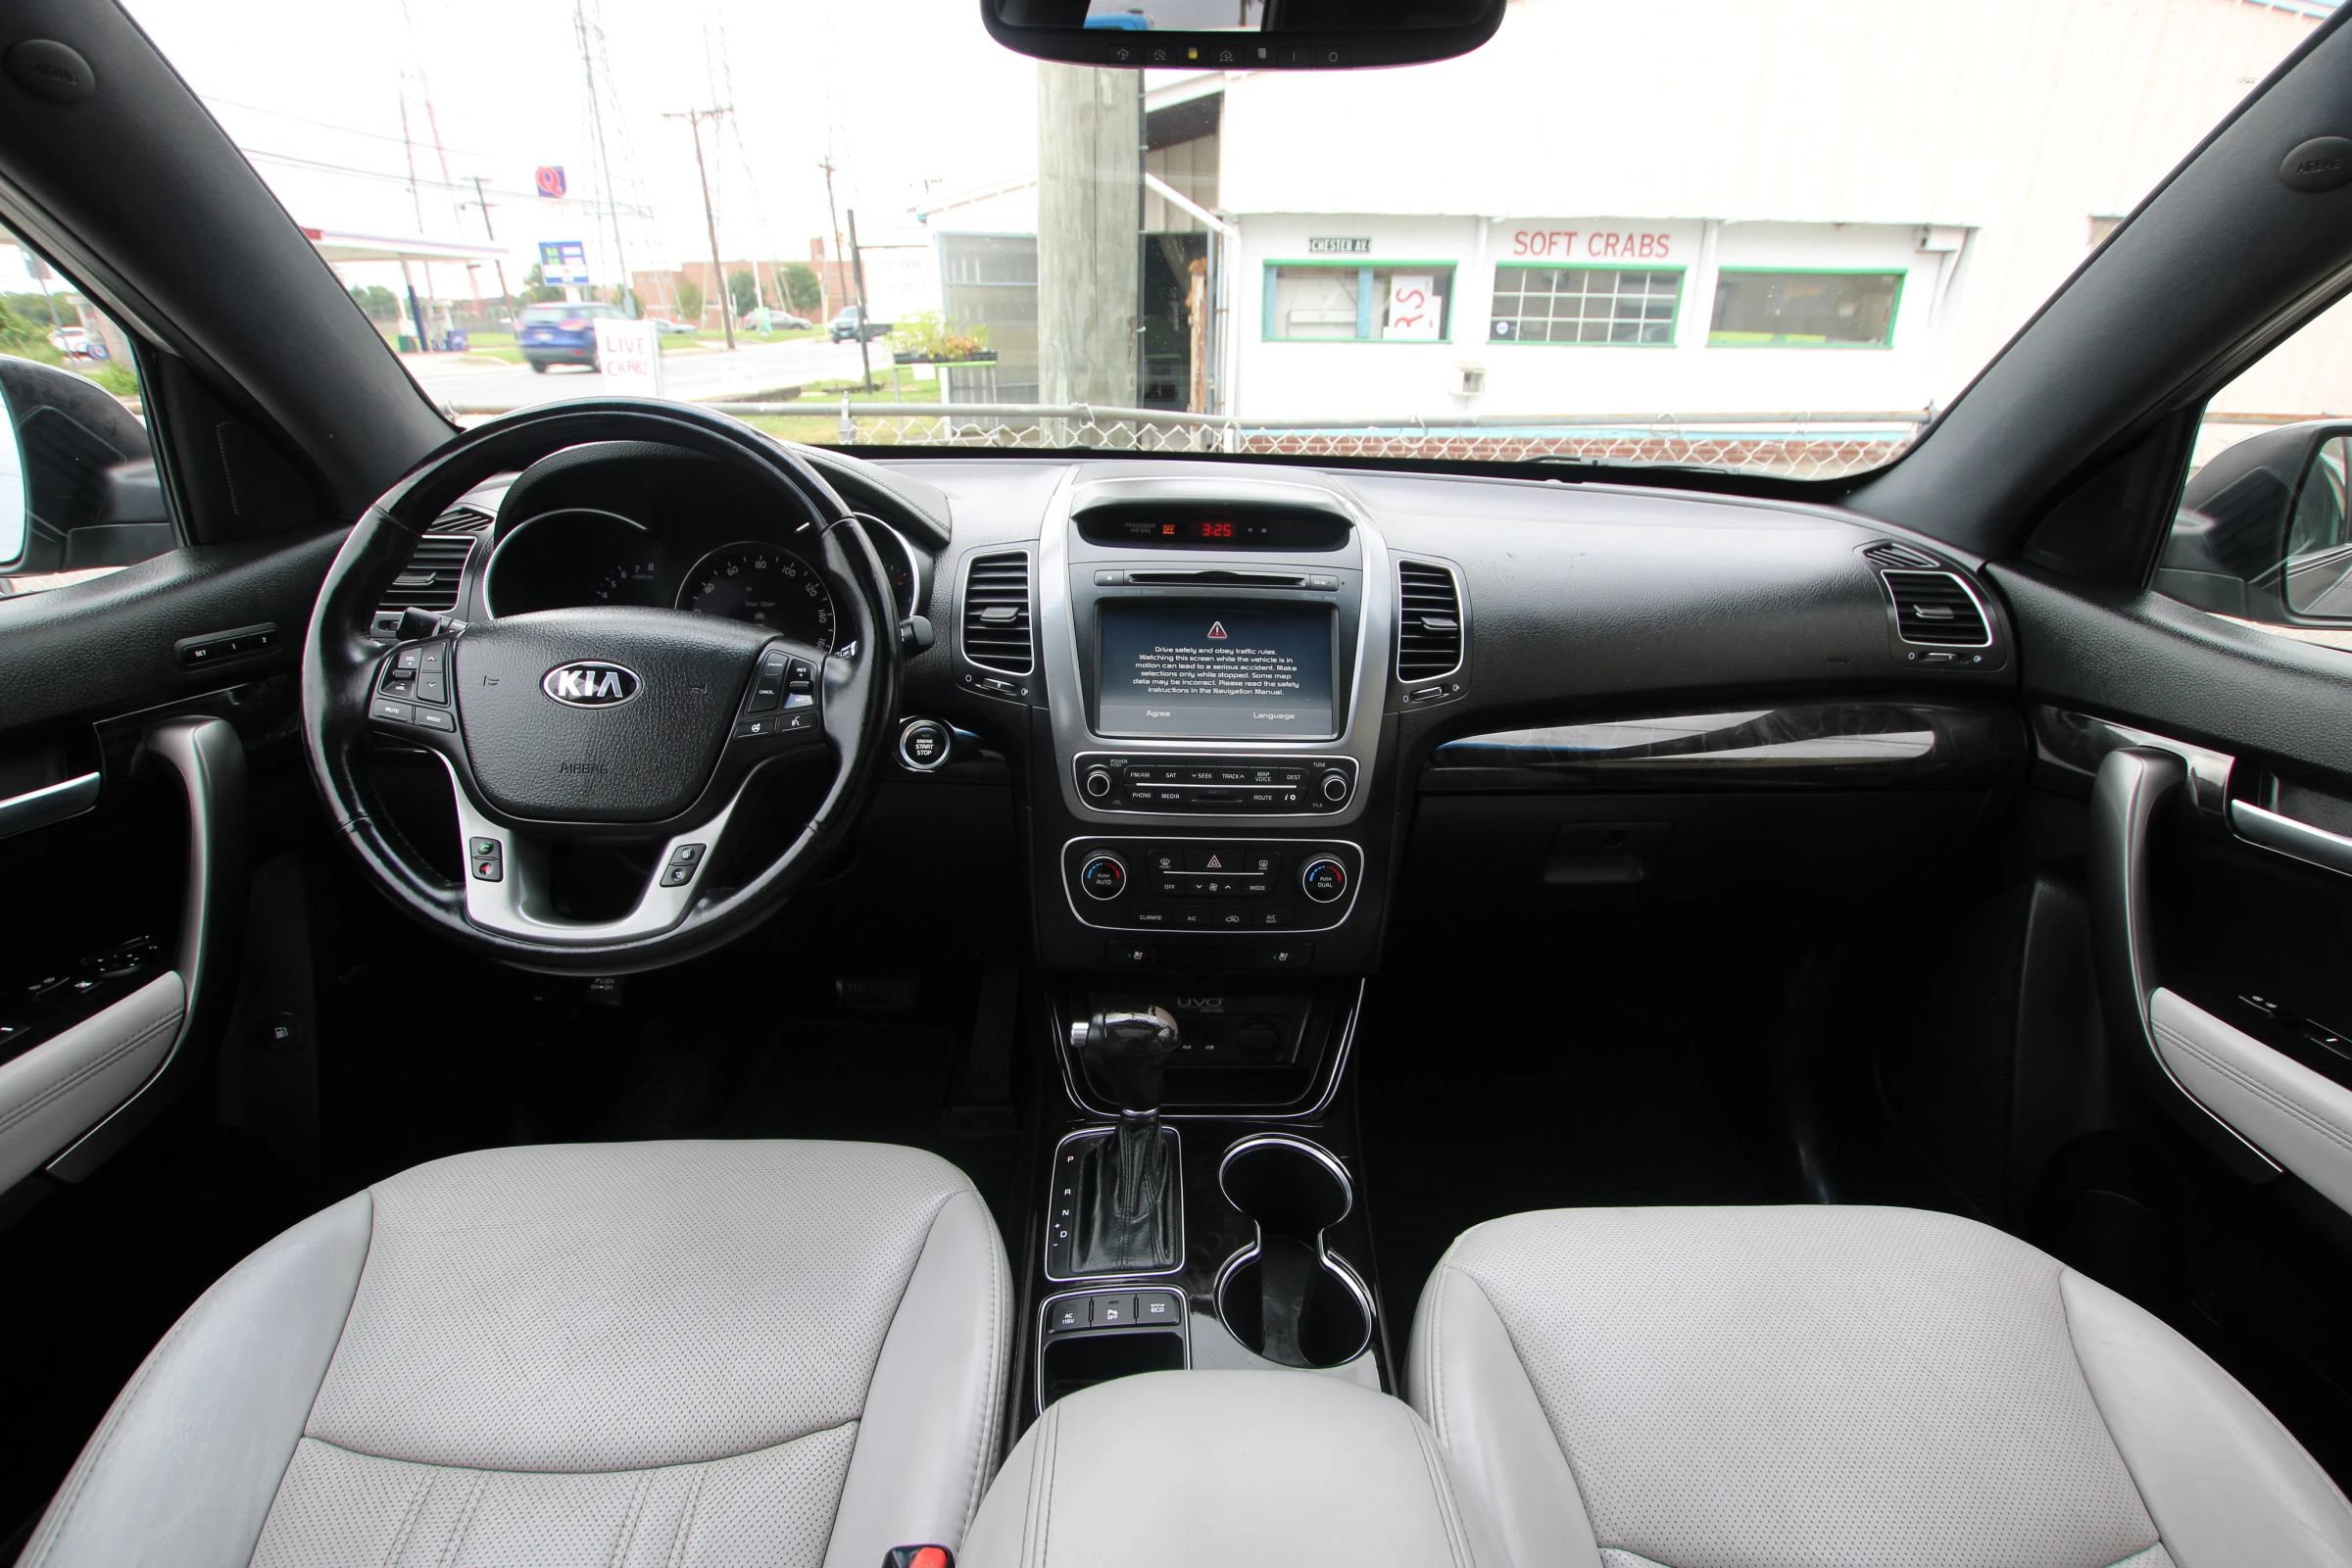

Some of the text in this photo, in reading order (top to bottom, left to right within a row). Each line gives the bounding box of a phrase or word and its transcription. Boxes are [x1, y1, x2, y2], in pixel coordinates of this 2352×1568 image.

[535, 166, 566, 198] Q
[1311, 238, 1352, 252] CHESTER
[1513, 231, 1671, 258] SOFT CRABS
[606, 336, 644, 355] LIVE
[1202, 522, 1232, 537] 3:25
[727, 565, 739, 576] 60
[755, 561, 767, 570] 80
[782, 566, 797, 578] 100
[620, 570, 627, 579] 6
[601, 591, 609, 600] 4
[704, 583, 715, 595] 40
[805, 582, 818, 597] 120
[818, 609, 827, 624] 140
[558, 670, 623, 698] KIA
[560, 762, 610, 775] AIRBAG
